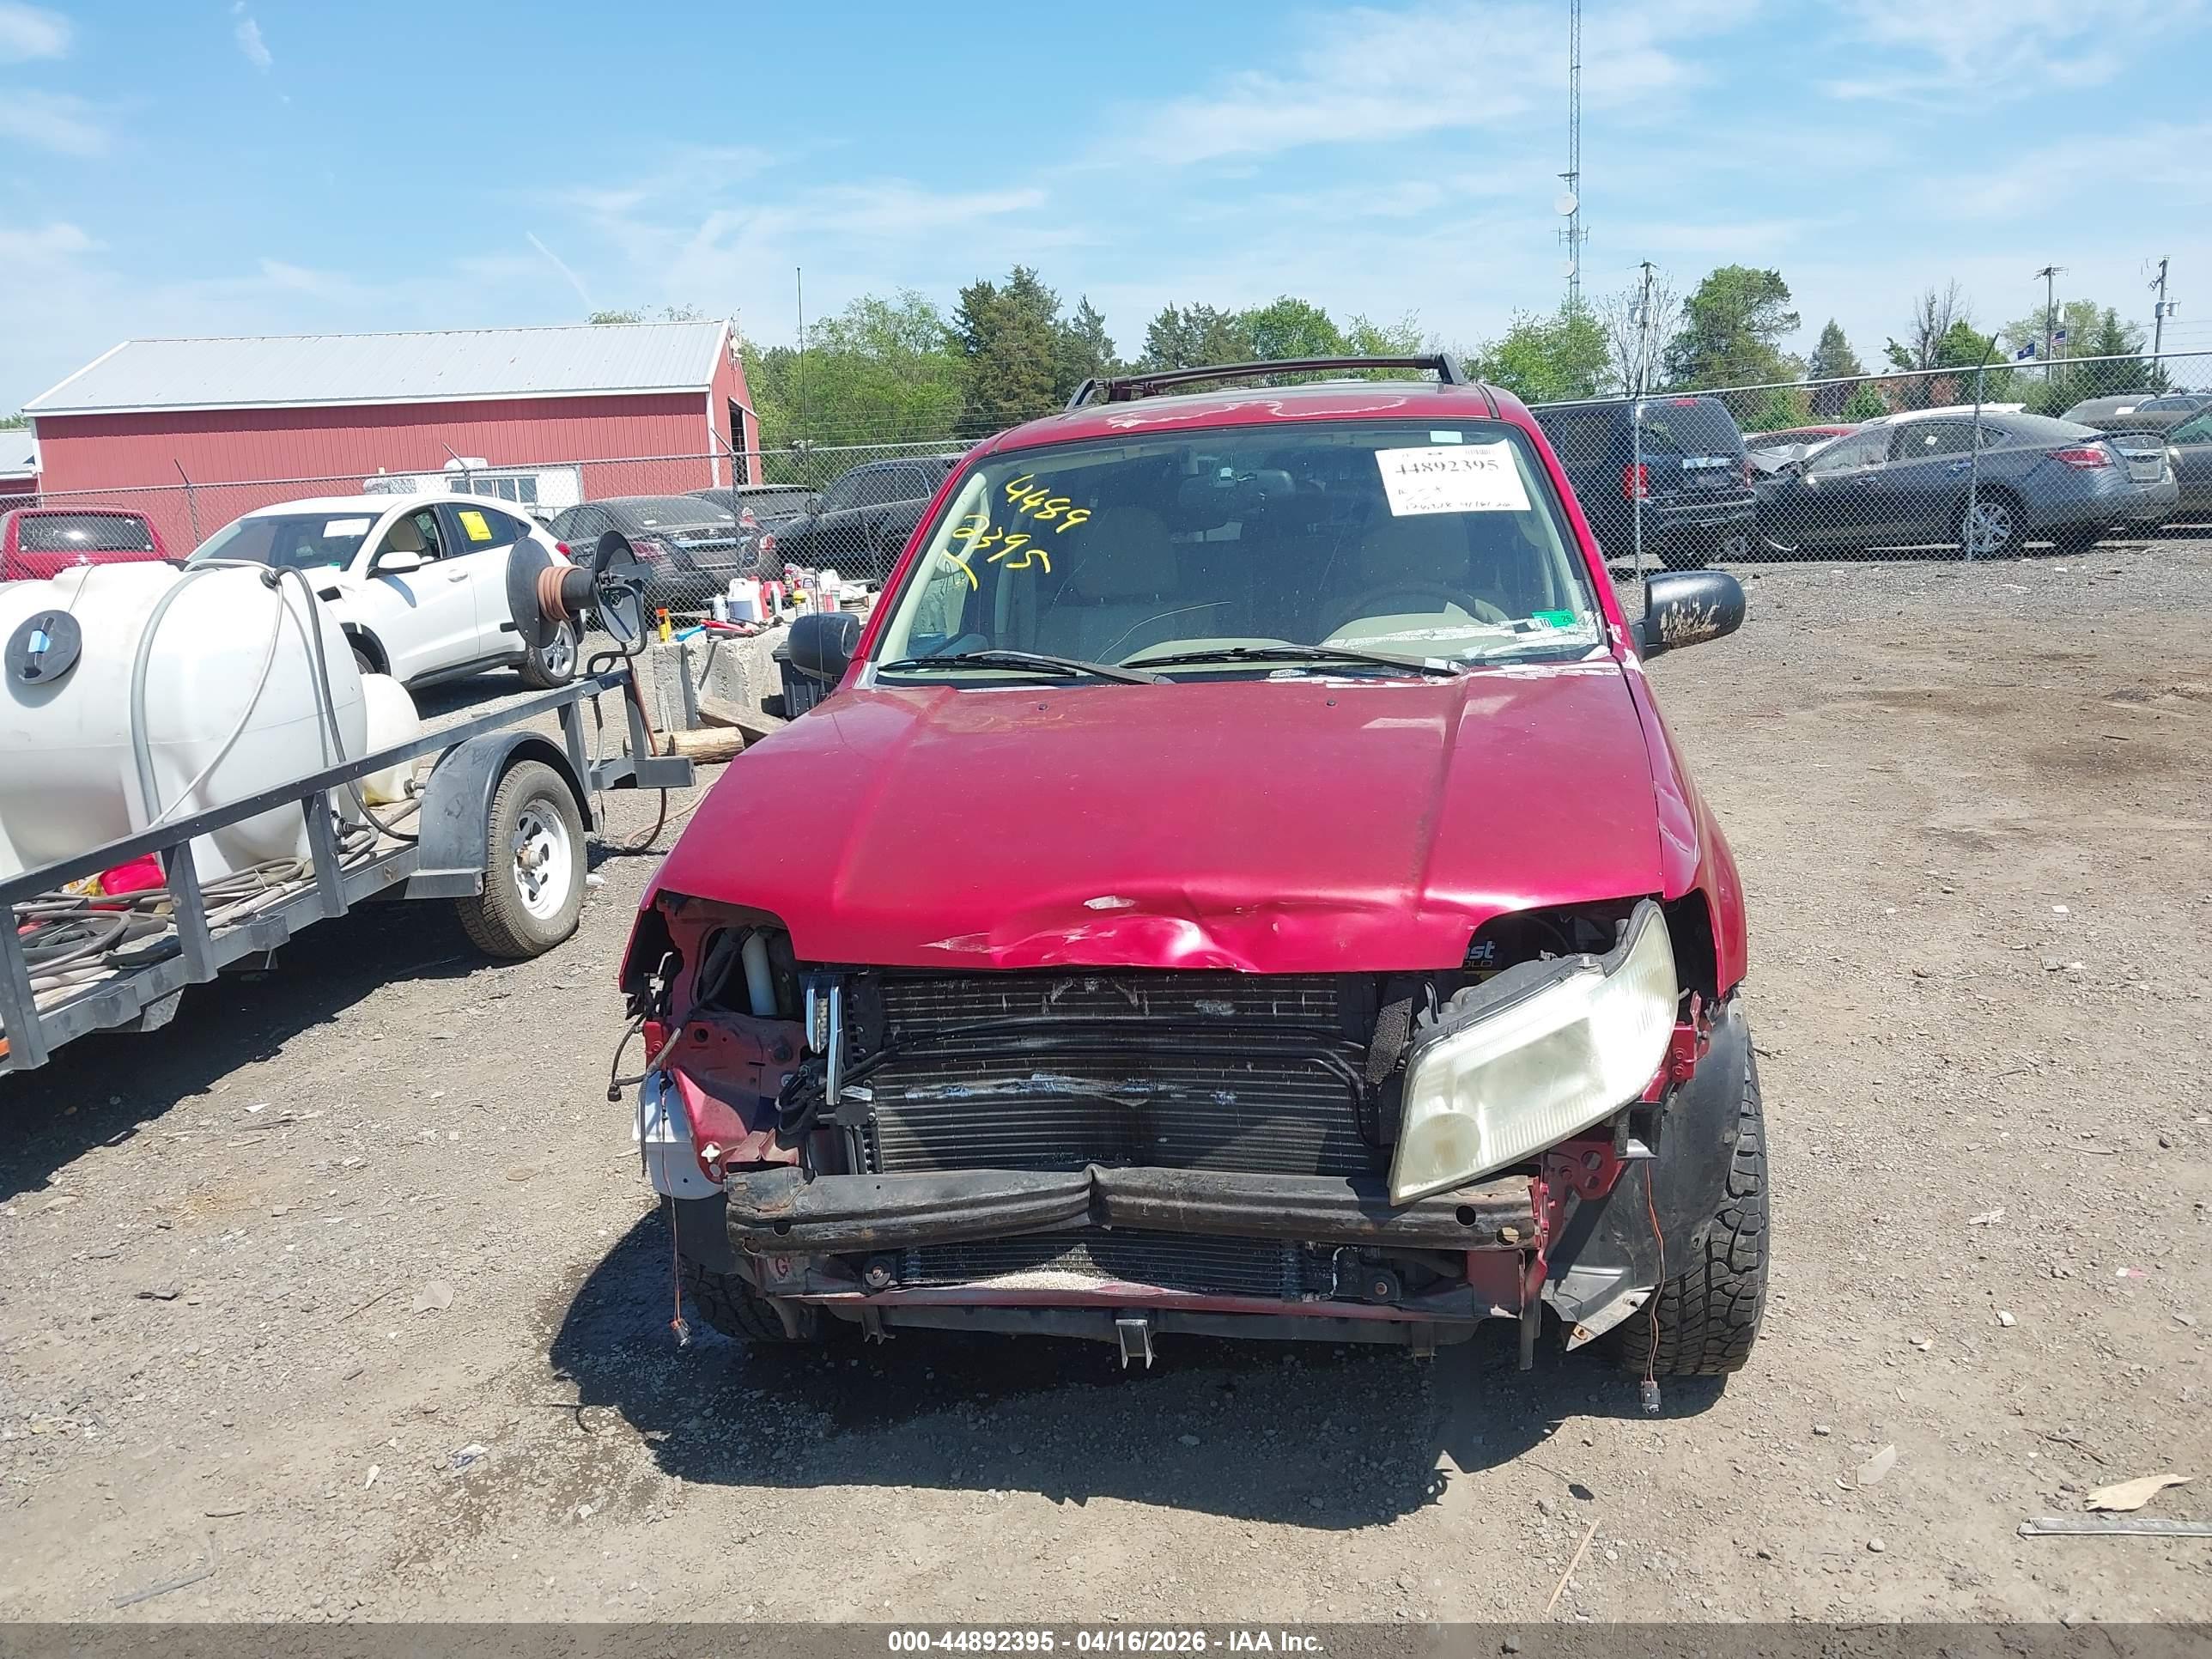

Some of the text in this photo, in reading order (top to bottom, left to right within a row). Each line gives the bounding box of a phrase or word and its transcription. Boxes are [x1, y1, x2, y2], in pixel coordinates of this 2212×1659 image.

[1395, 459, 1498, 475] 44892395
[1006, 473, 1091, 534] 4489
[952, 514, 1051, 574] 2395
